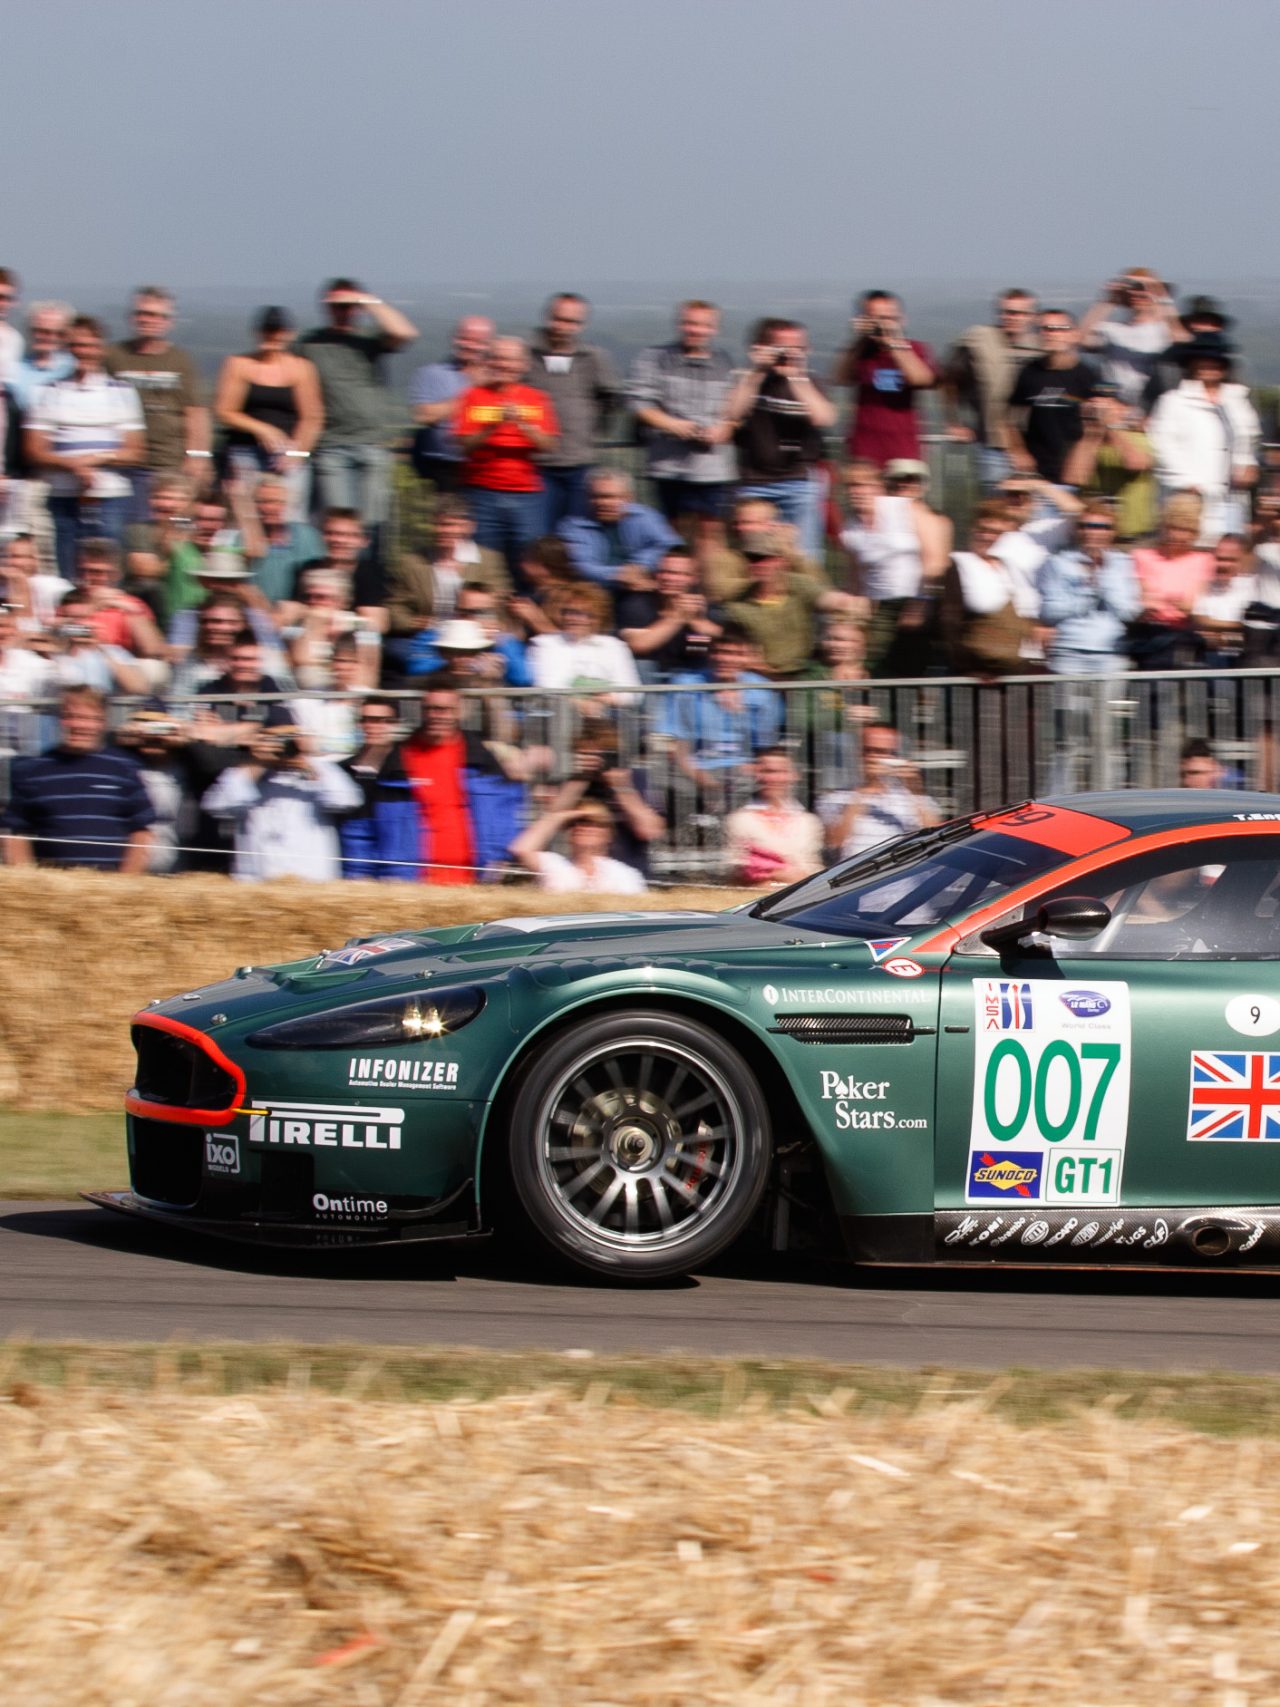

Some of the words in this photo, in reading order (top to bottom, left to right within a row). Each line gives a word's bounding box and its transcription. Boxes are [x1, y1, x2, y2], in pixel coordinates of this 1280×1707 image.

[1250, 1006, 1260, 1024] 9
[349, 1058, 459, 1082] INFONIZER
[984, 1038, 1121, 1142] 007
[250, 1101, 405, 1149] PIRELLI
[835, 1101, 928, 1129] Stars.com
[977, 1169, 1034, 1181] SUNOCO
[1054, 1156, 1113, 1194] GT1
[313, 1193, 388, 1213] Ontime
